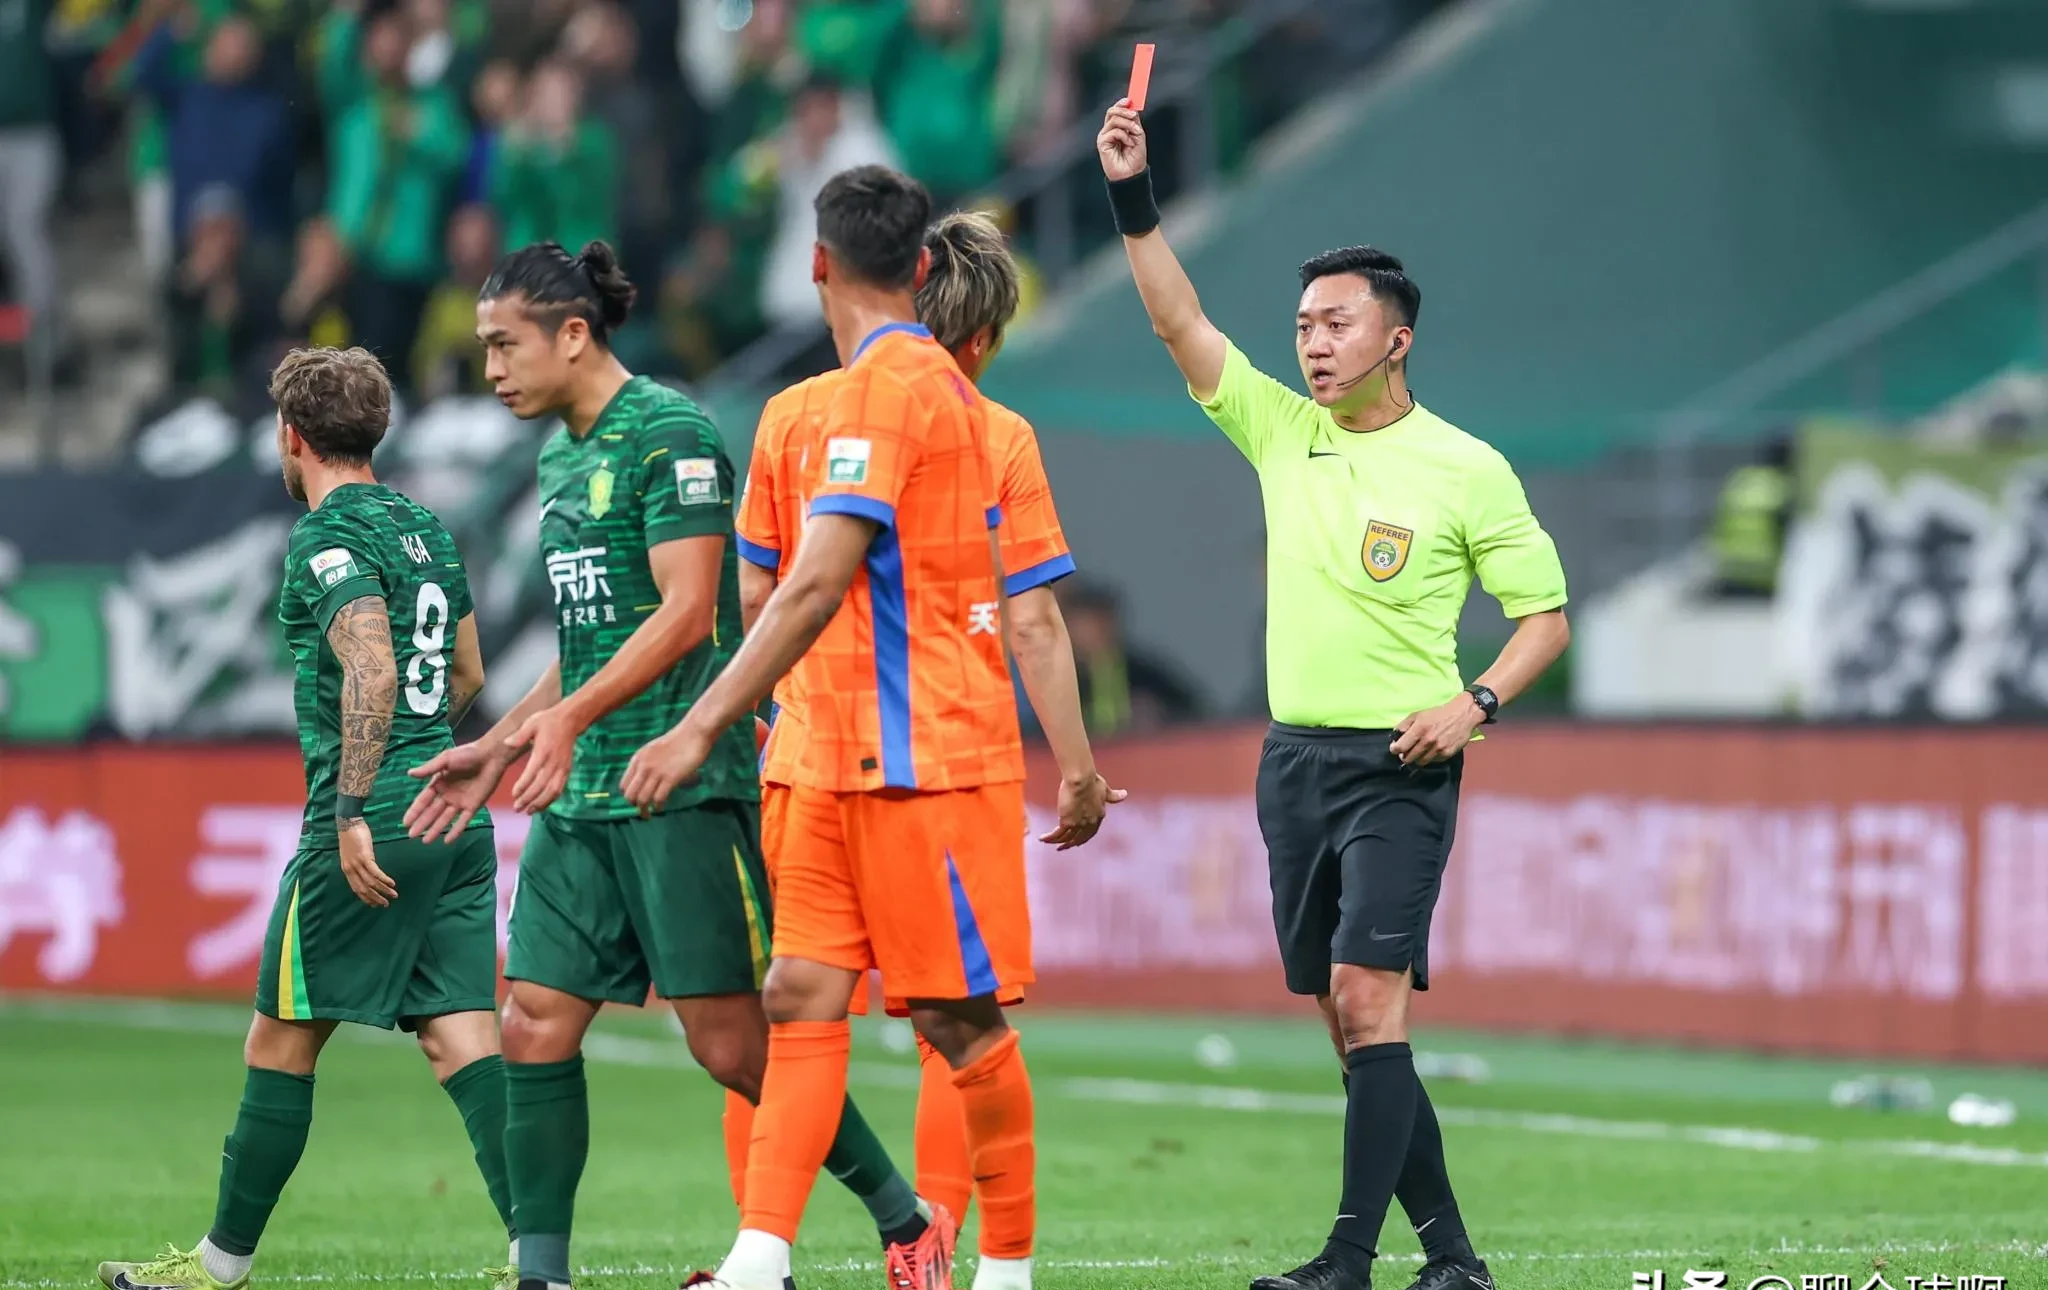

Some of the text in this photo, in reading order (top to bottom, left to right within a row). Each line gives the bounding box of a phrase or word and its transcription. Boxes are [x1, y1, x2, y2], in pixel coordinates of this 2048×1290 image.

[1371, 525, 1409, 541] REFEREE
[545, 546, 612, 605] 京东
[967, 601, 999, 635] 天
[405, 582, 448, 715] 8
